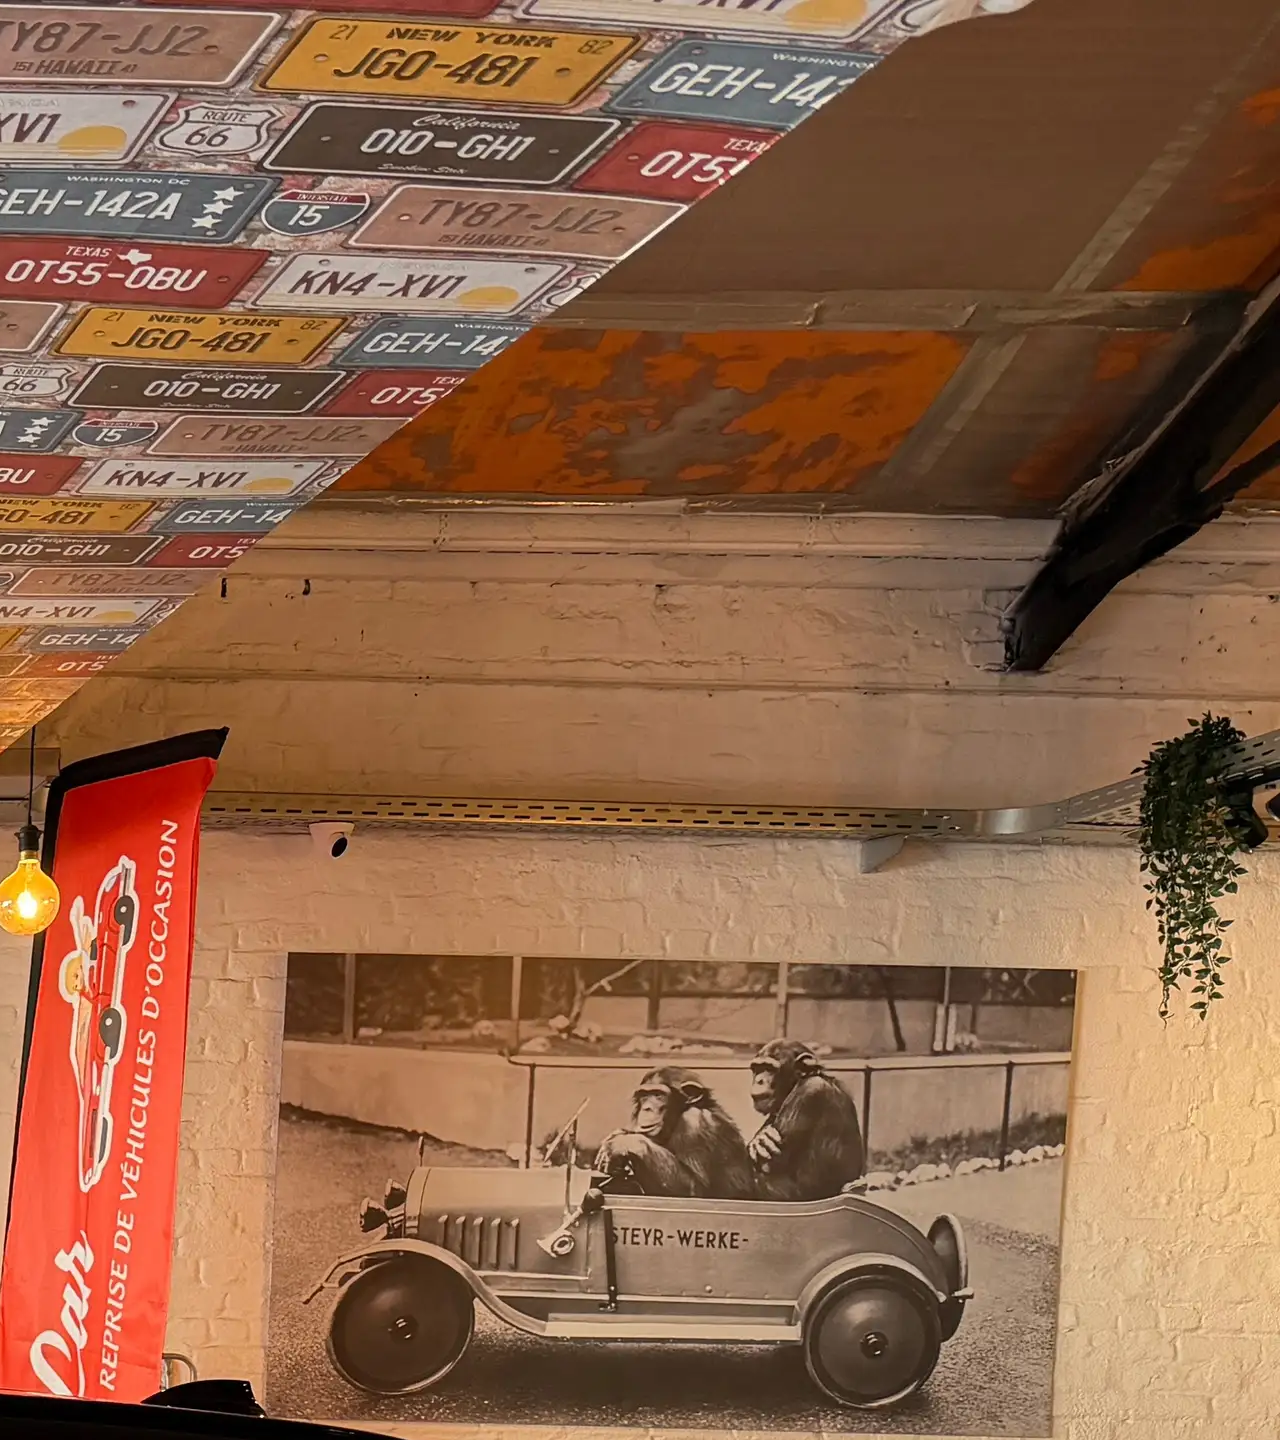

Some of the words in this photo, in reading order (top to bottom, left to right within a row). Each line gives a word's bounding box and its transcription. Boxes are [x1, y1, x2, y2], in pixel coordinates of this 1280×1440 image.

[326, 25, 358, 41] 21
[383, 26, 466, 42] NEW
[467, 26, 566, 45] YORK
[578, 30, 620, 46] 82
[33, 62, 122, 80] HAWAII
[200, 111, 255, 122] ROUTE
[409, 113, 528, 131] California
[181, 125, 237, 147] 66
[64, 175, 164, 185] WASHINGTON
[283, 205, 334, 226] 15
[142, 819, 179, 1021] D'OCCASION
[120, 1028, 156, 1200] VÉHICULES
[113, 1210, 135, 1254] DE
[29, 1229, 94, 1398] Car
[100, 1264, 128, 1391] REPRISE
